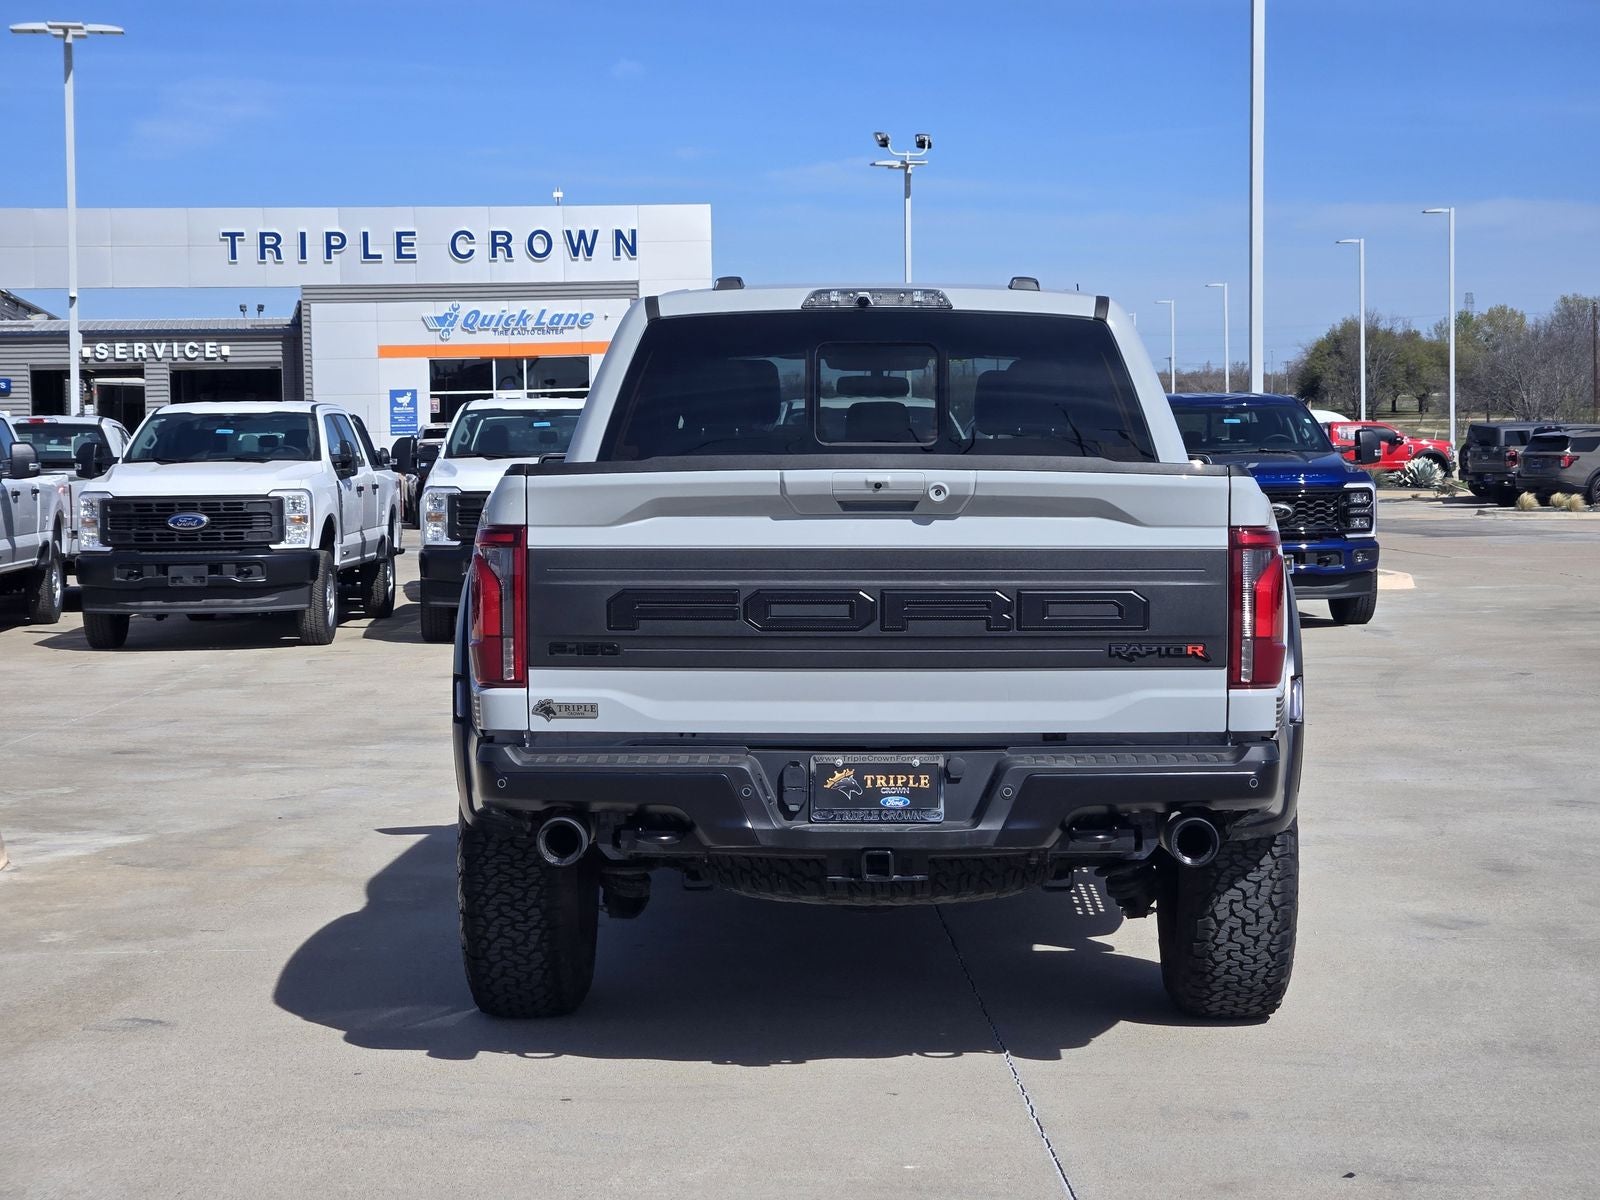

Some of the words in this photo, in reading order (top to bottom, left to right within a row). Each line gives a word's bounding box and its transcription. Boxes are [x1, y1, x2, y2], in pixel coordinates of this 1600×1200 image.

[219, 230, 418, 263] TRIPLE
[447, 228, 639, 262] CROWN
[461, 309, 532, 332] Quick
[533, 308, 595, 329] Lane
[492, 329, 510, 337] TIRE
[516, 328, 536, 336] AUTO
[536, 328, 565, 336] CENTER
[95, 341, 218, 360] SERVICE
[606, 588, 1150, 632] FORD
[1108, 642, 1212, 662] RAPTOR
[556, 704, 597, 713] TRIPLE
[817, 755, 940, 763] wwwTripleCrownFordcom
[863, 774, 930, 788] TRIPLE
[833, 809, 880, 821] TRIPLE
[881, 809, 922, 821] CROWN
